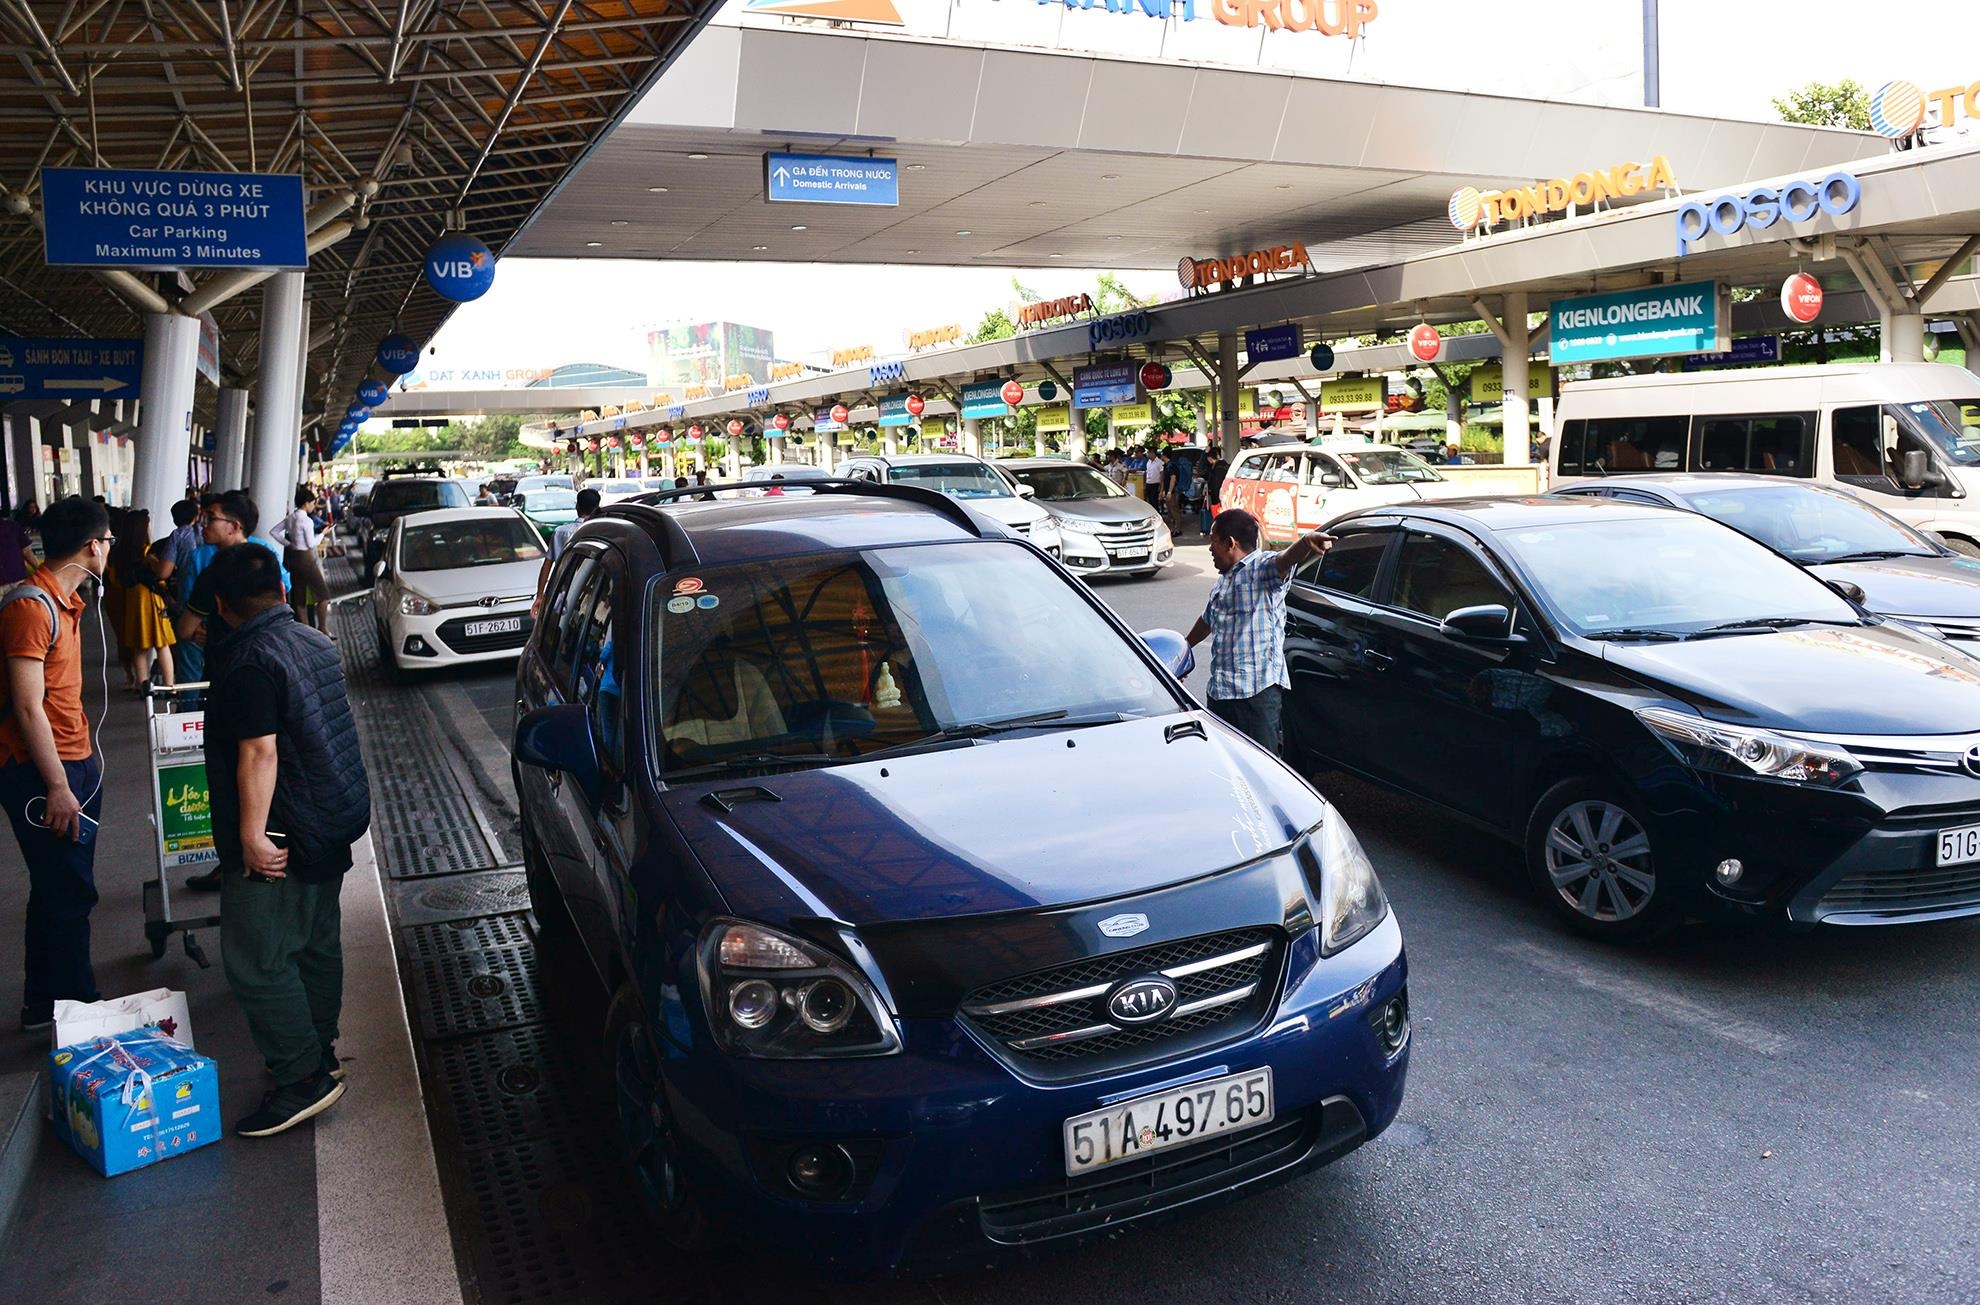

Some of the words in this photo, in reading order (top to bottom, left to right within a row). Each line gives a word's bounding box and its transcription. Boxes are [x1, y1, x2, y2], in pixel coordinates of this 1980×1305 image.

[793, 166, 806, 176] GA
[809, 165, 828, 176] ĐẾN
[831, 168, 863, 178] TRONG
[866, 169, 892, 180] NƯỚC
[85, 180, 126, 194] KHU
[132, 180, 171, 198] VỰC
[179, 180, 233, 197] DỪNG
[239, 184, 263, 197] XE
[793, 179, 832, 189] Domestic
[835, 181, 867, 190] Arrivals
[80, 198, 151, 216] KHÔNG
[157, 201, 198, 216] QUÁ
[204, 204, 214, 217] 3
[221, 201, 270, 218] PHÚT
[129, 225, 158, 237] Car
[164, 225, 227, 241] Parking
[96, 244, 176, 257] Maximum
[182, 245, 191, 257] 3
[197, 245, 261, 258] Minutes
[433, 261, 472, 279] VIB
[1798, 294, 1821, 303] VIFON
[1558, 295, 1704, 330] KIENLONGBANK
[1418, 338, 1438, 348] VIFON
[72, 350, 92, 365] TAXI
[100, 350, 111, 365] XE
[381, 349, 406, 360] VIB
[462, 369, 501, 381] XANH
[506, 368, 554, 381] GROUP
[361, 390, 378, 398] VIB
[964, 387, 1001, 402] KIENLONGBAN
[1330, 393, 1374, 406] 0933.33.99.88
[466, 618, 520, 636] 51F-262.10
[1120, 988, 1166, 1015] KIA
[1073, 1076, 1265, 1164] 51A497.65
